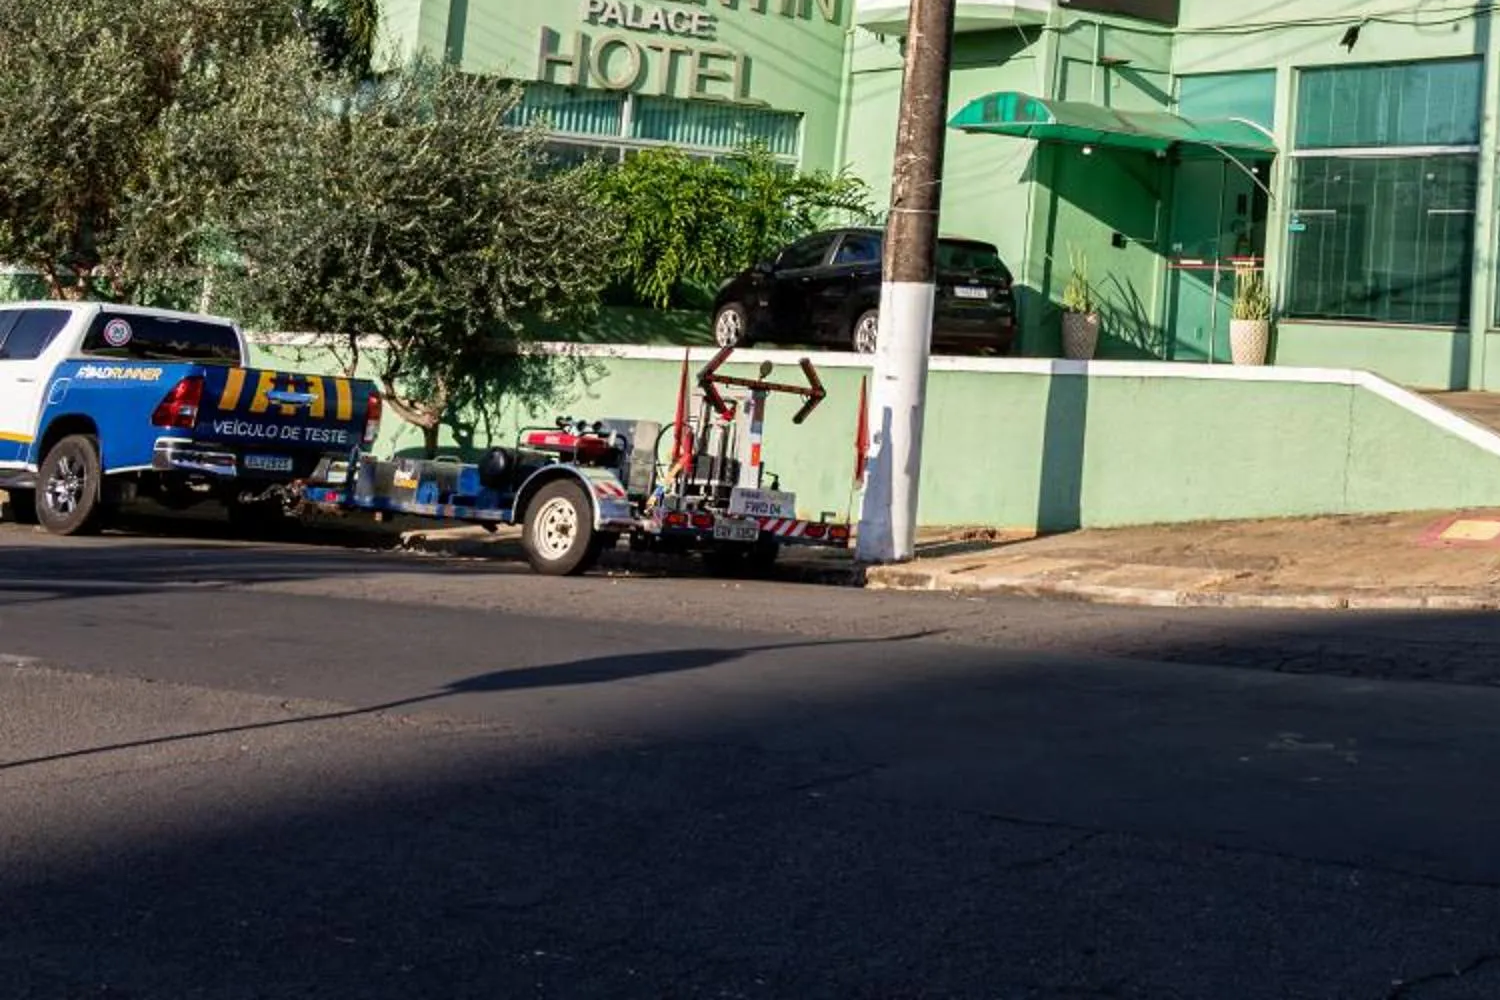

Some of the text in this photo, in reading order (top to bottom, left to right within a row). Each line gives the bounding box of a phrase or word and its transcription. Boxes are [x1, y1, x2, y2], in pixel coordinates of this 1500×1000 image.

[537, 24, 771, 107] HOTEL
[280, 425, 301, 441] DE
[304, 427, 348, 443] TESTE
